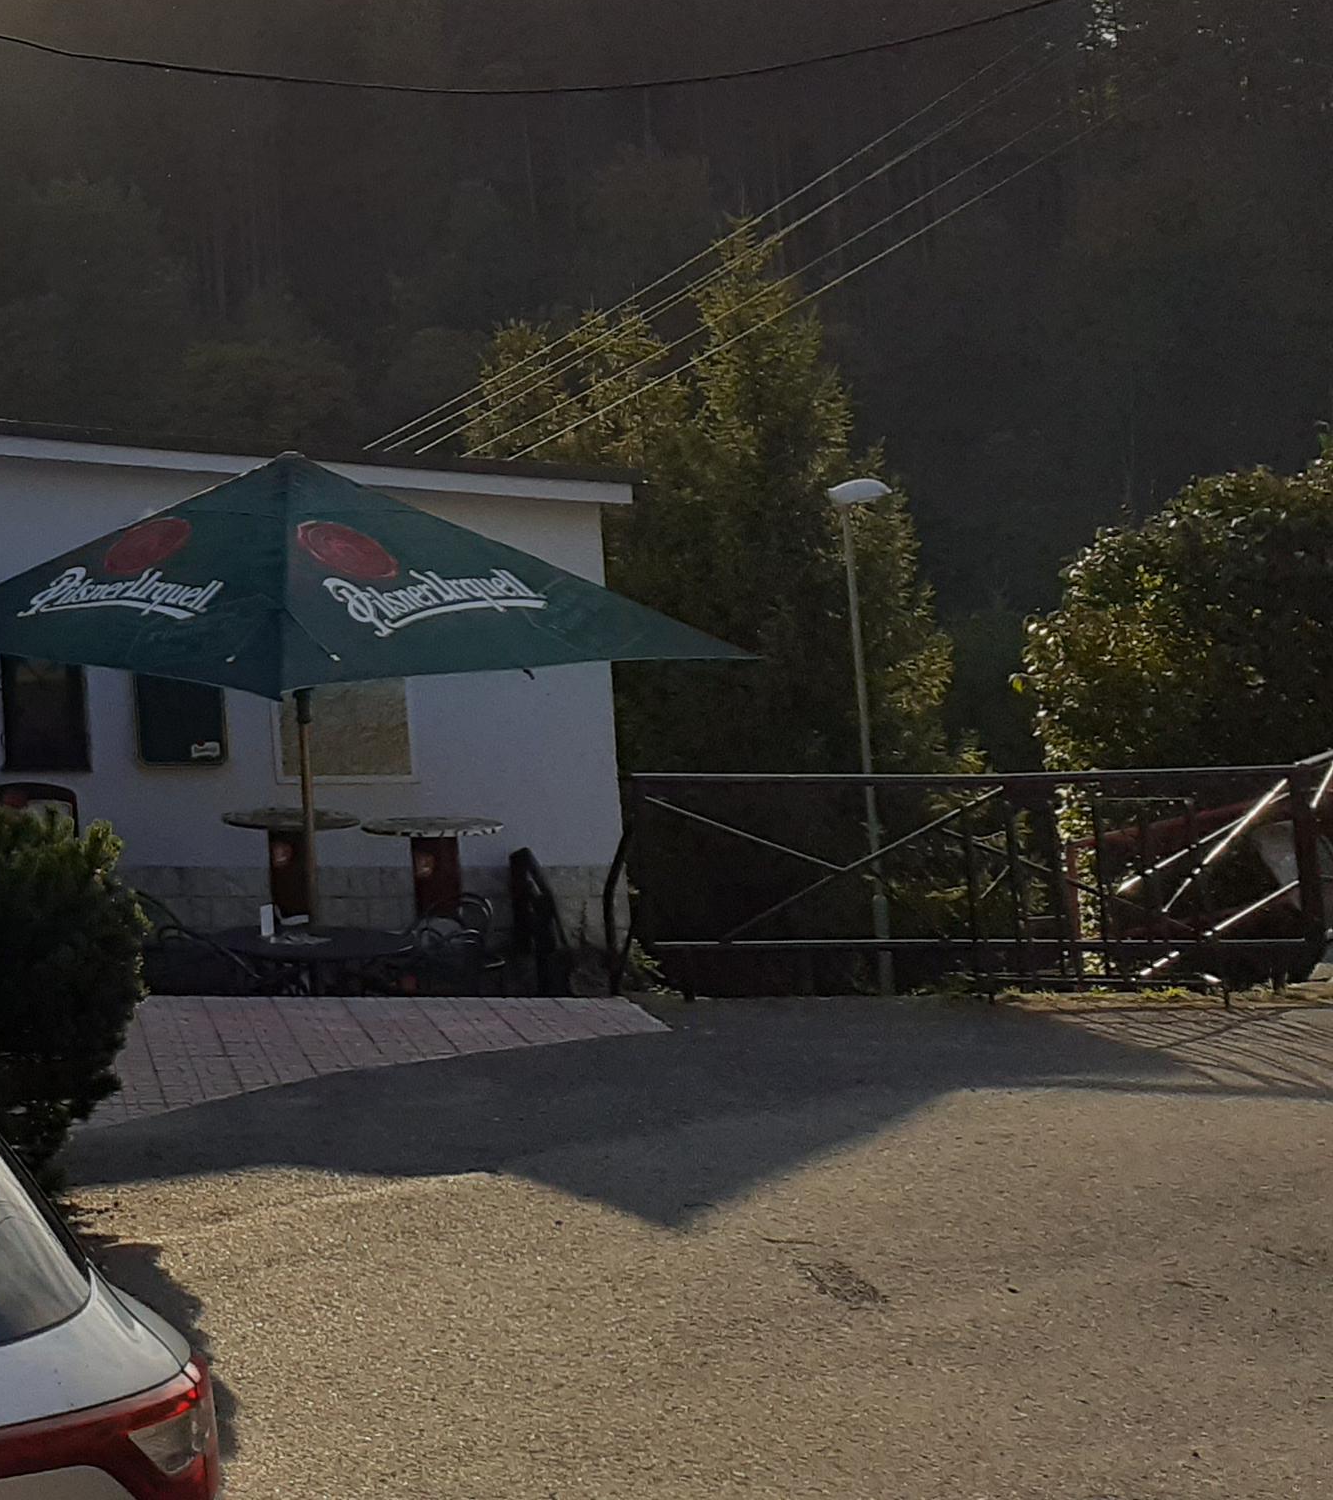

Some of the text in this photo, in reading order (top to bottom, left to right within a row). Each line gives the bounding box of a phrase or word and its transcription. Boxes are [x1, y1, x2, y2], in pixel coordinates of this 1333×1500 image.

[17, 566, 224, 617] Pilsner Urquell
[323, 569, 547, 637] Pilsner Urquell
